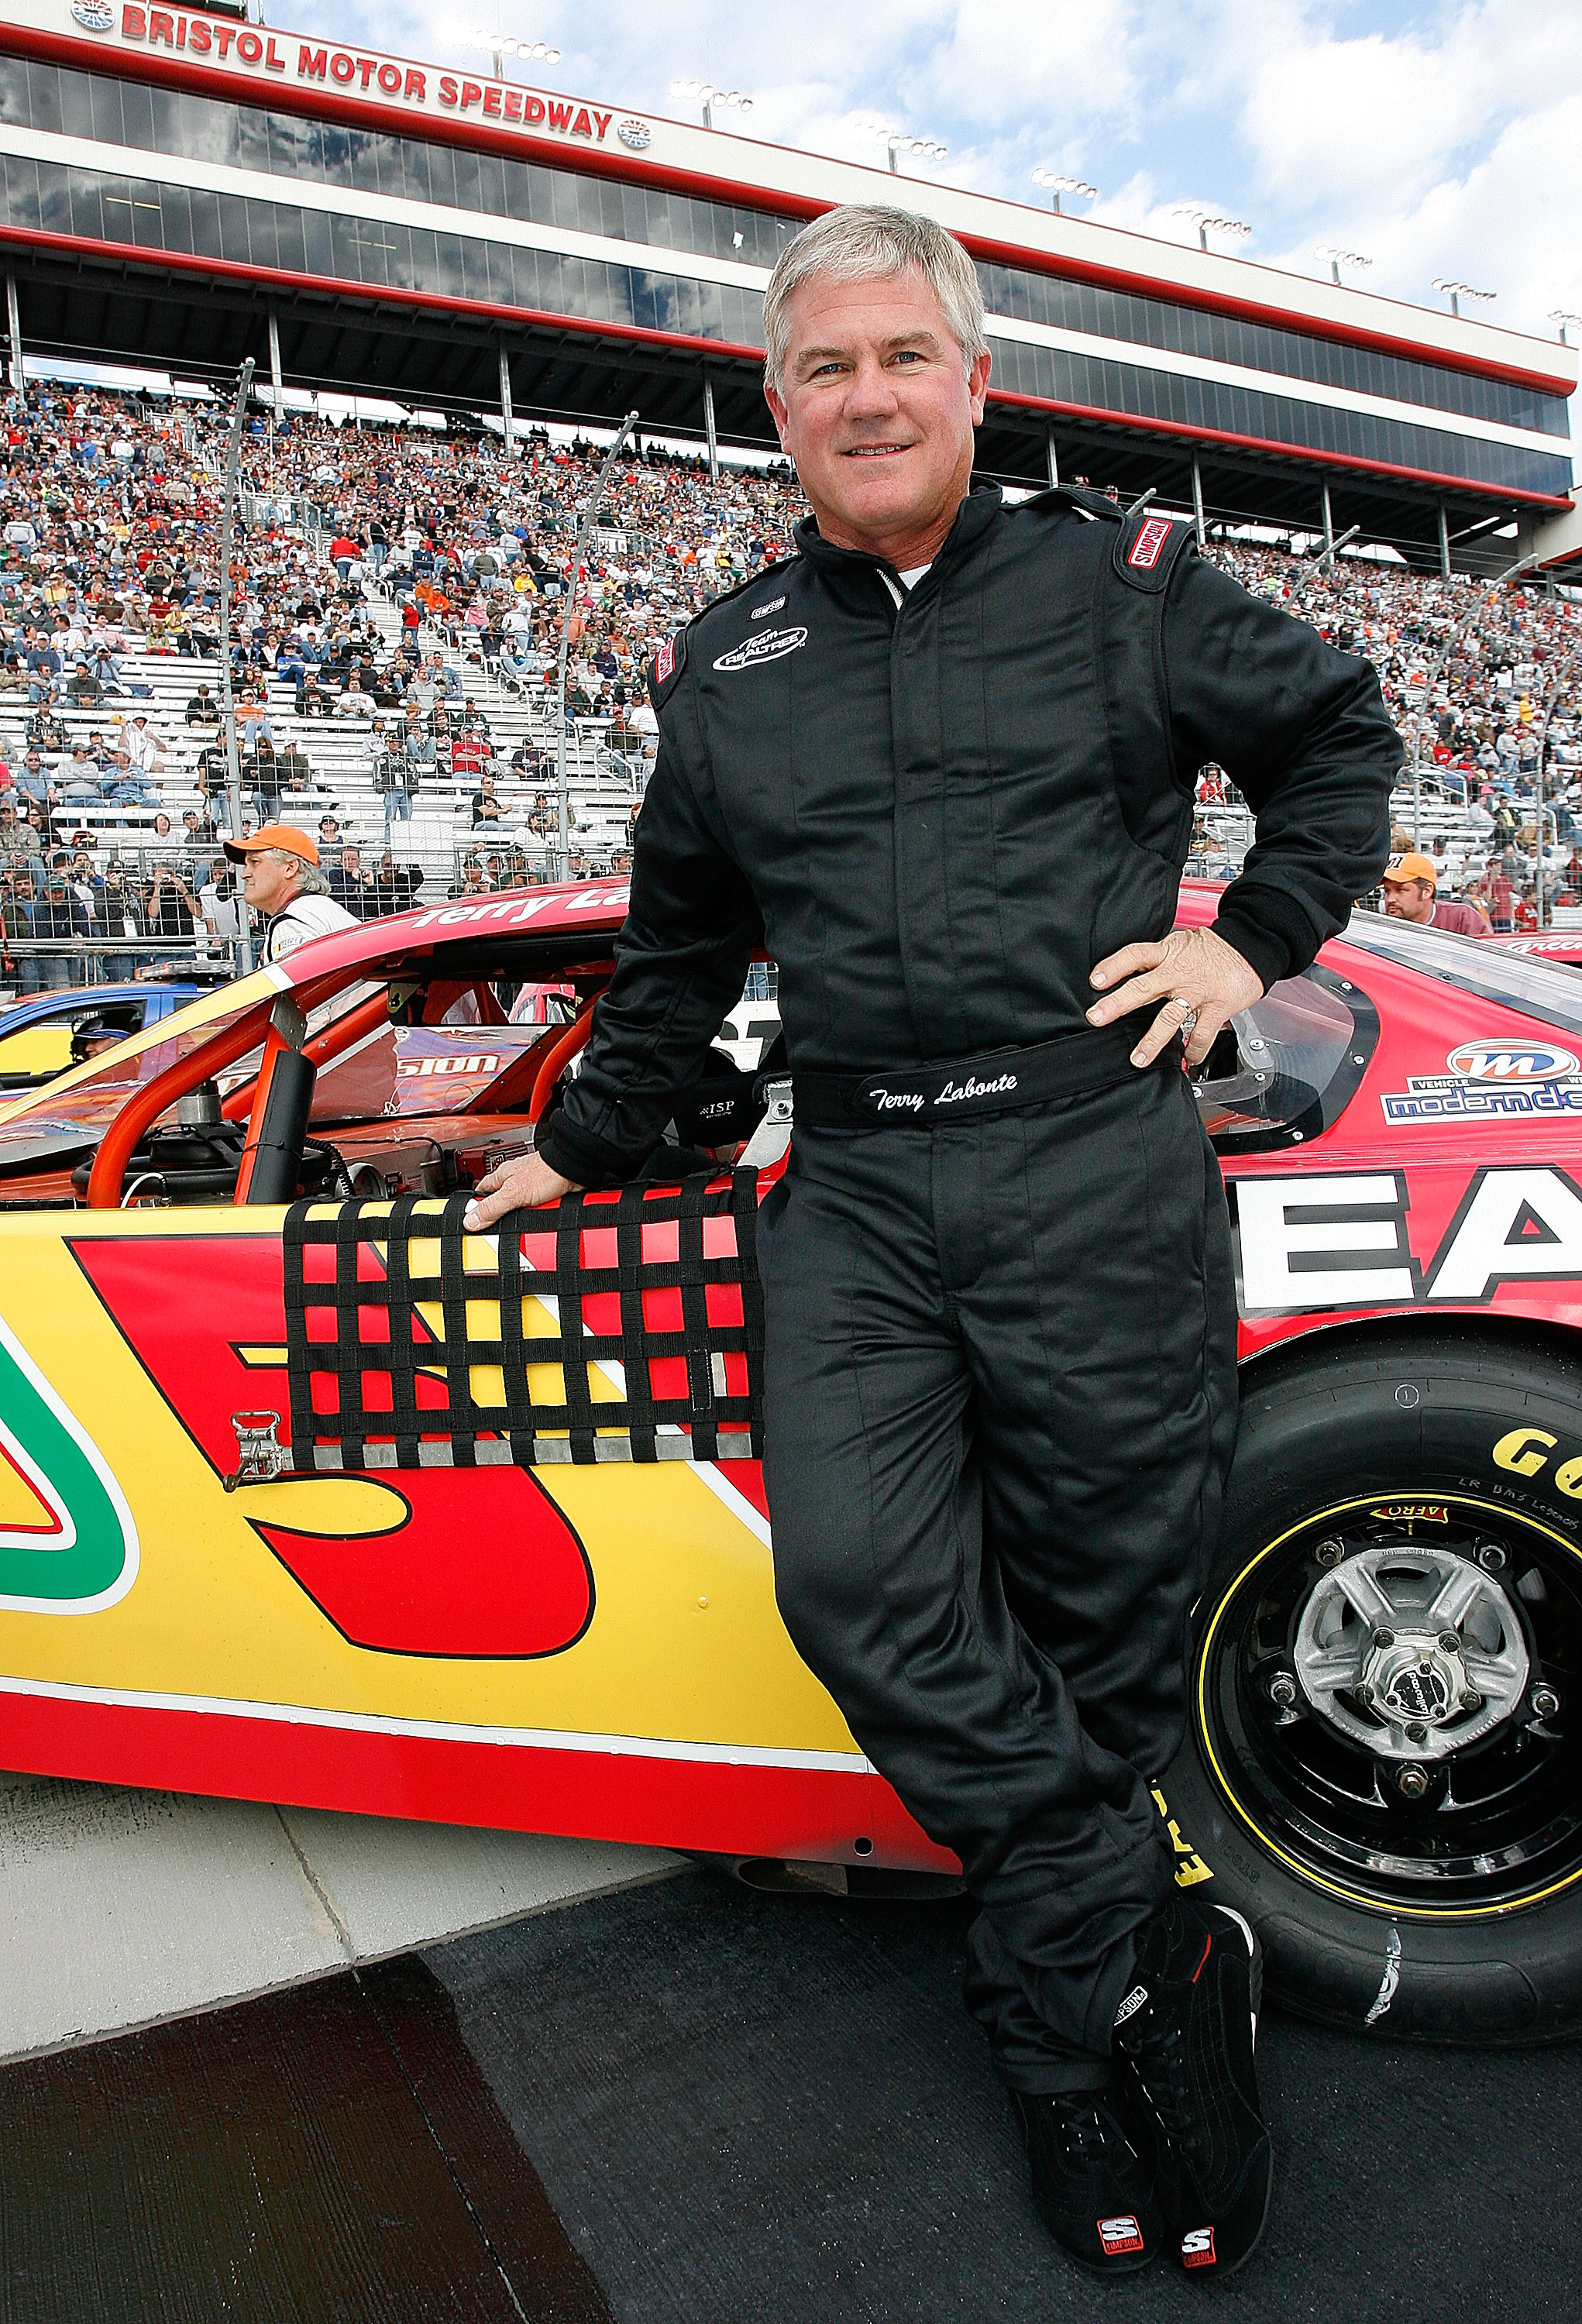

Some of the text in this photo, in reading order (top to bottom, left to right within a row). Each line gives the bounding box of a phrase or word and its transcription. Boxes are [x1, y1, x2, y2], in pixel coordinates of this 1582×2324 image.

[122, 4, 614, 141] BRISTOL MOTOR SPEEDWAY
[1135, 522, 1167, 563] SIMPSON
[725, 631, 800, 665] REALTREE
[739, 628, 779, 651] Team
[411, 895, 565, 929] Terry
[869, 1073, 1018, 1112] Terry Labonte
[1417, 1078, 1470, 1090] VEHICLE
[710, 1100, 735, 1114] ISP
[1391, 1088, 1530, 1116] modern
[1236, 1169, 1582, 1309] EA
[1101, 2218, 1138, 2241] S
[1106, 2236, 1138, 2251] SIMPSON
[1181, 2229, 1211, 2254] S
